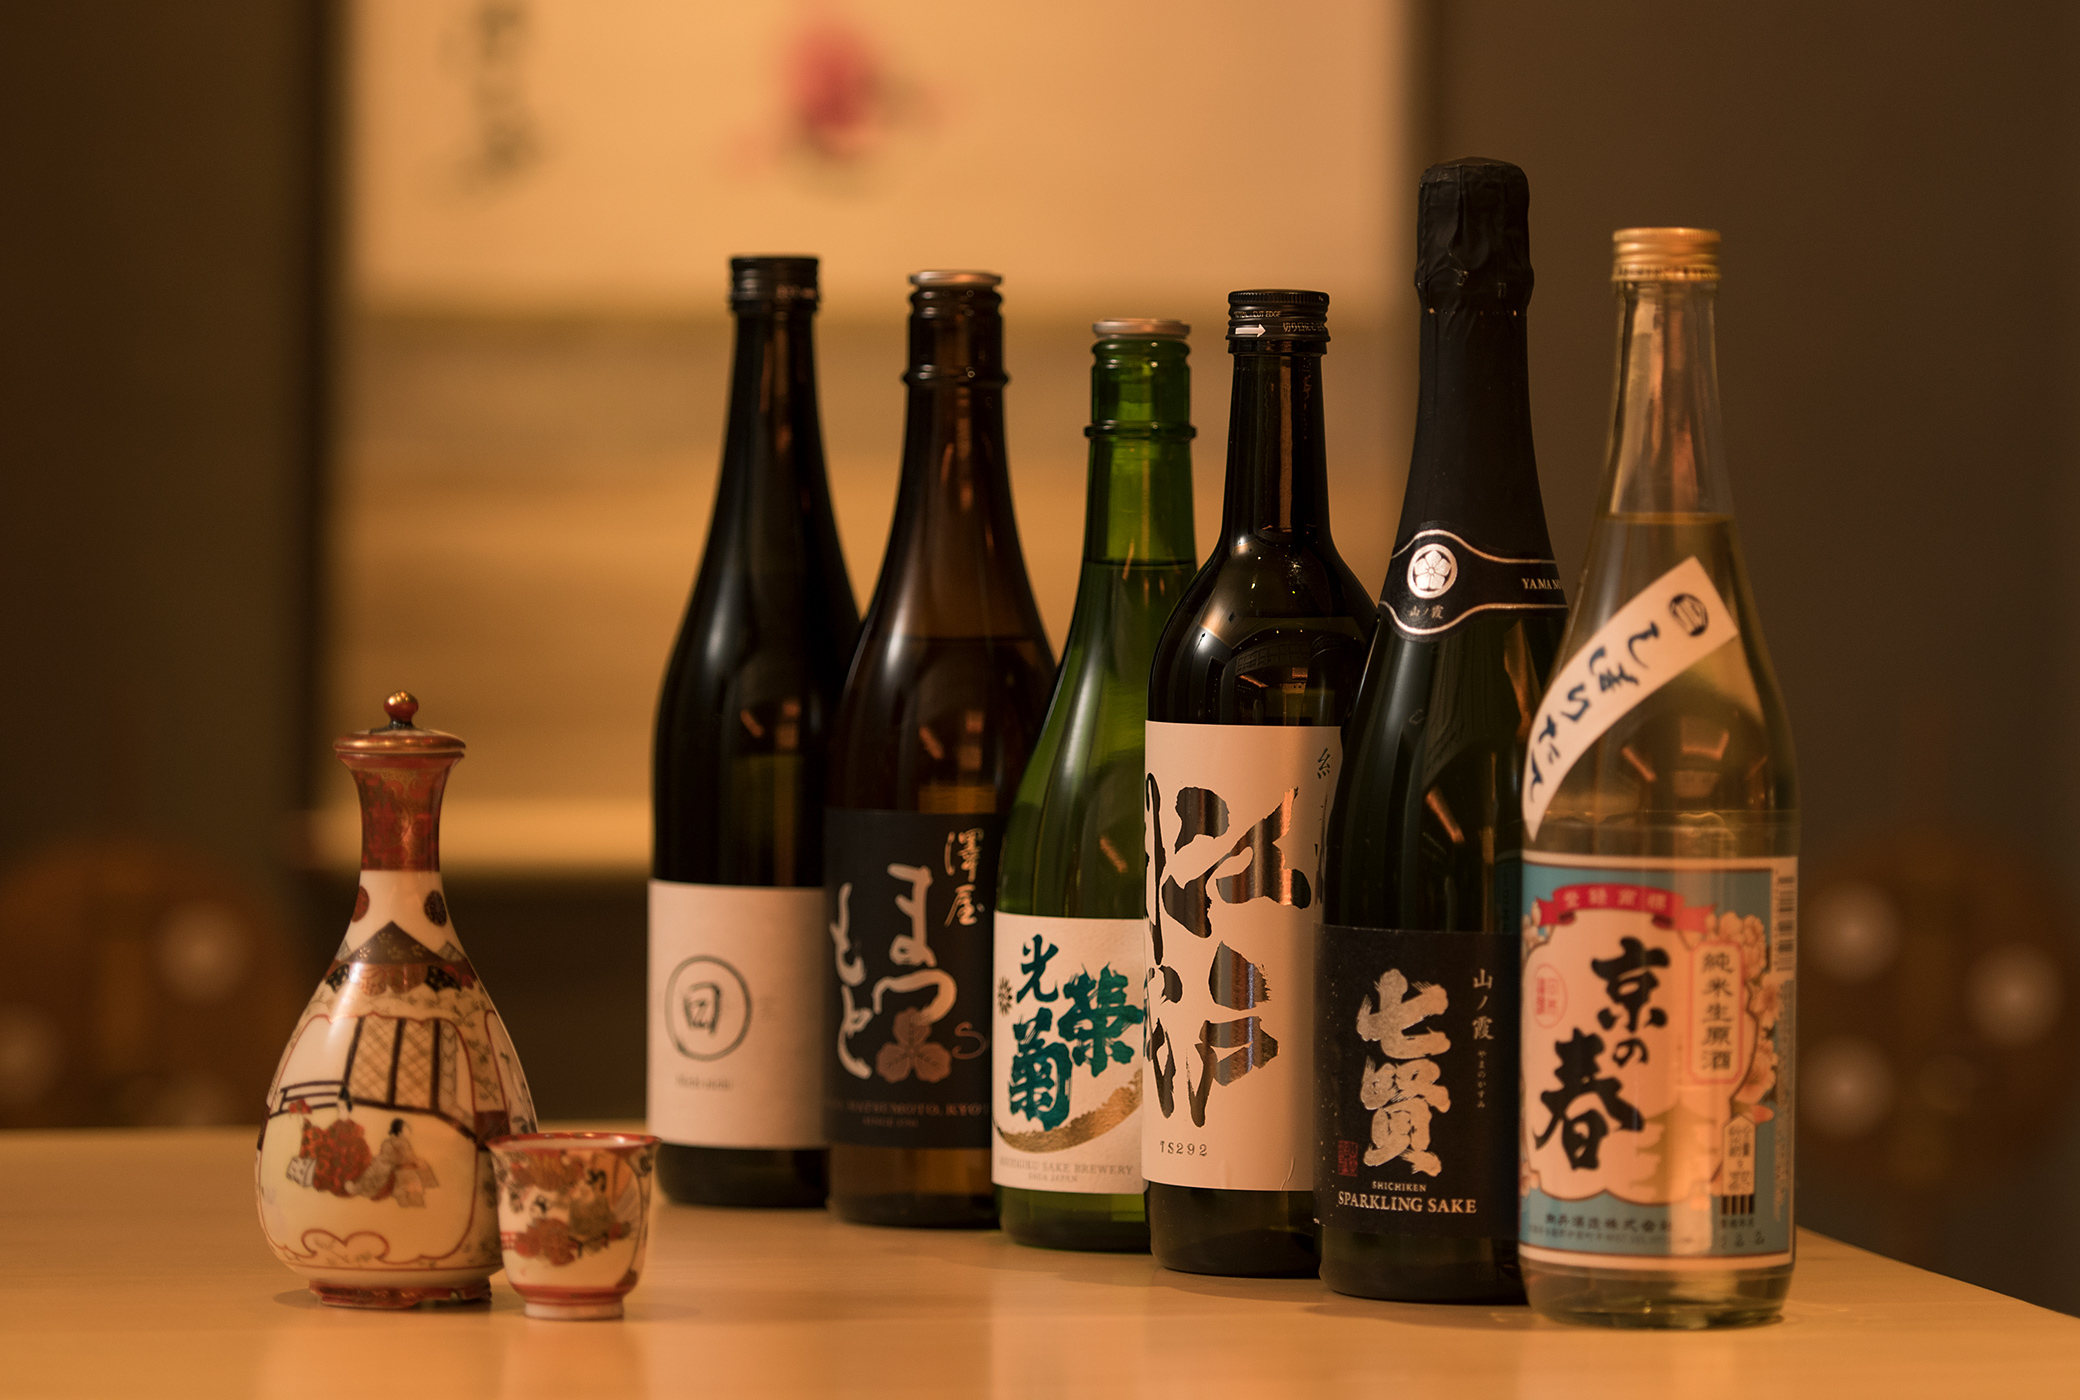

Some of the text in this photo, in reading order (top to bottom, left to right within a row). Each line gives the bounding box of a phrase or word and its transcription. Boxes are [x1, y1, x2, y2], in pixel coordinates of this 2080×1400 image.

[1530, 620, 1661, 803] しぼりたて
[1471, 968, 1495, 1040] 山ノ霞
[1701, 951, 1735, 1071] 純米生原酒
[1356, 968, 1452, 1178] 七賢
[1477, 1049, 1487, 1109] やまのかすみ
[1041, 1161, 1069, 1174] SAKE
[1073, 1163, 1134, 1176] BREWERY
[1371, 1180, 1428, 1193] SHICHIKEN
[1337, 1190, 1478, 1215] SPARKLING SAKE
